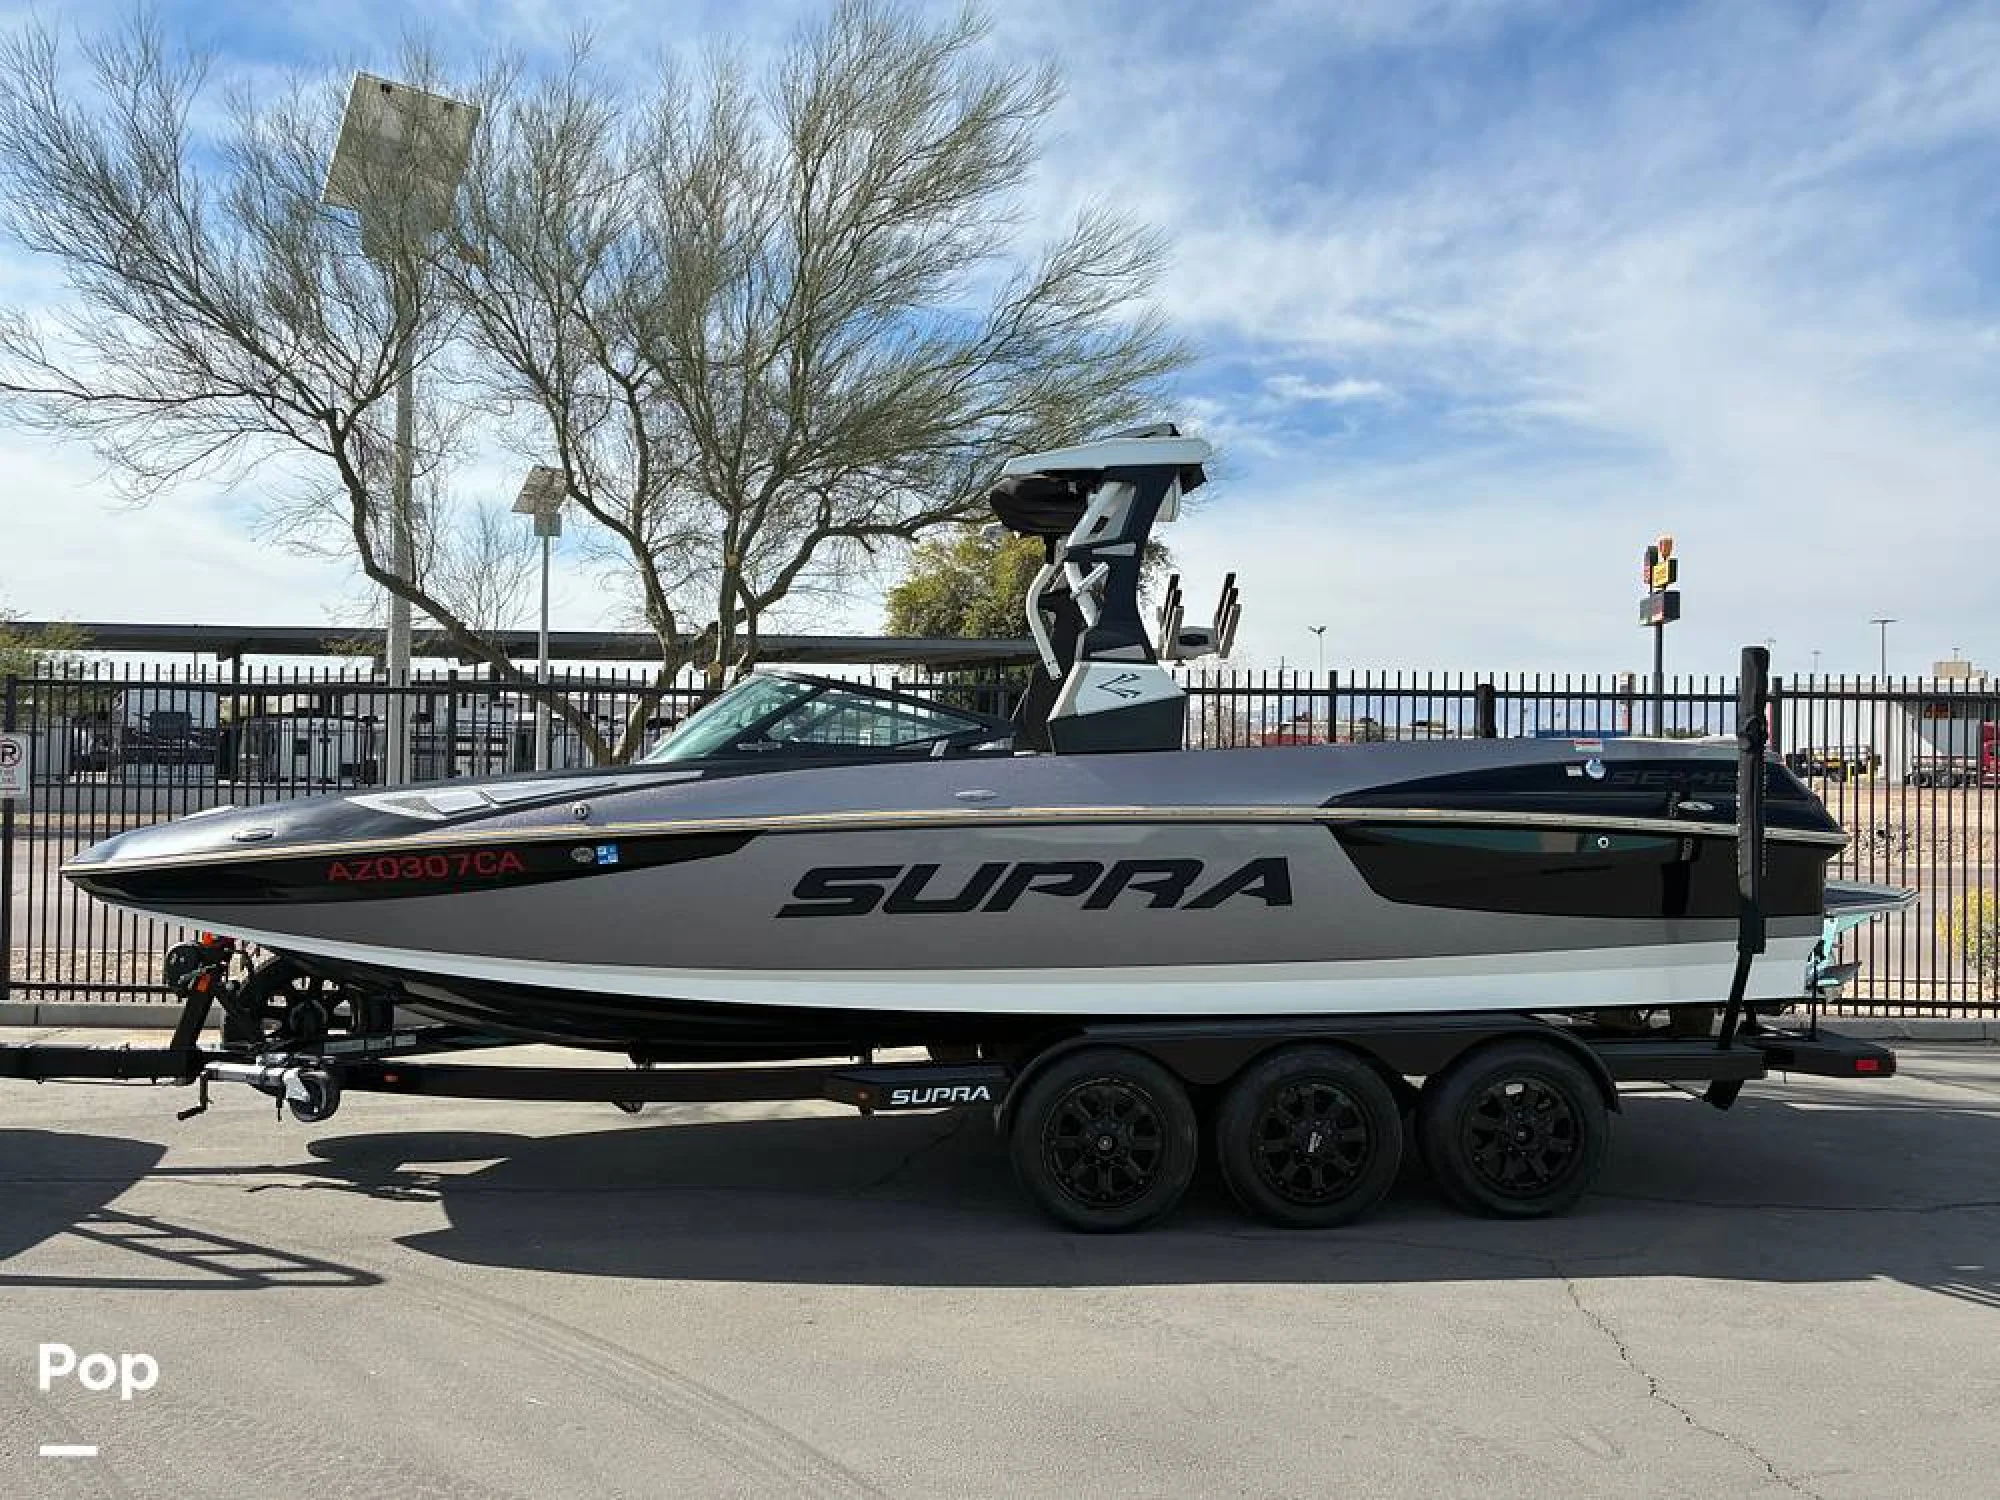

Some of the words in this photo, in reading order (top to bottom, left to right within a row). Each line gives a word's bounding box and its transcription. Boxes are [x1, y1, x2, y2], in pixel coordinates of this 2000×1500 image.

[327, 851, 526, 882] AZ0307CA
[774, 857, 1293, 919] SUPRA
[890, 1085, 991, 1105] SUPRA
